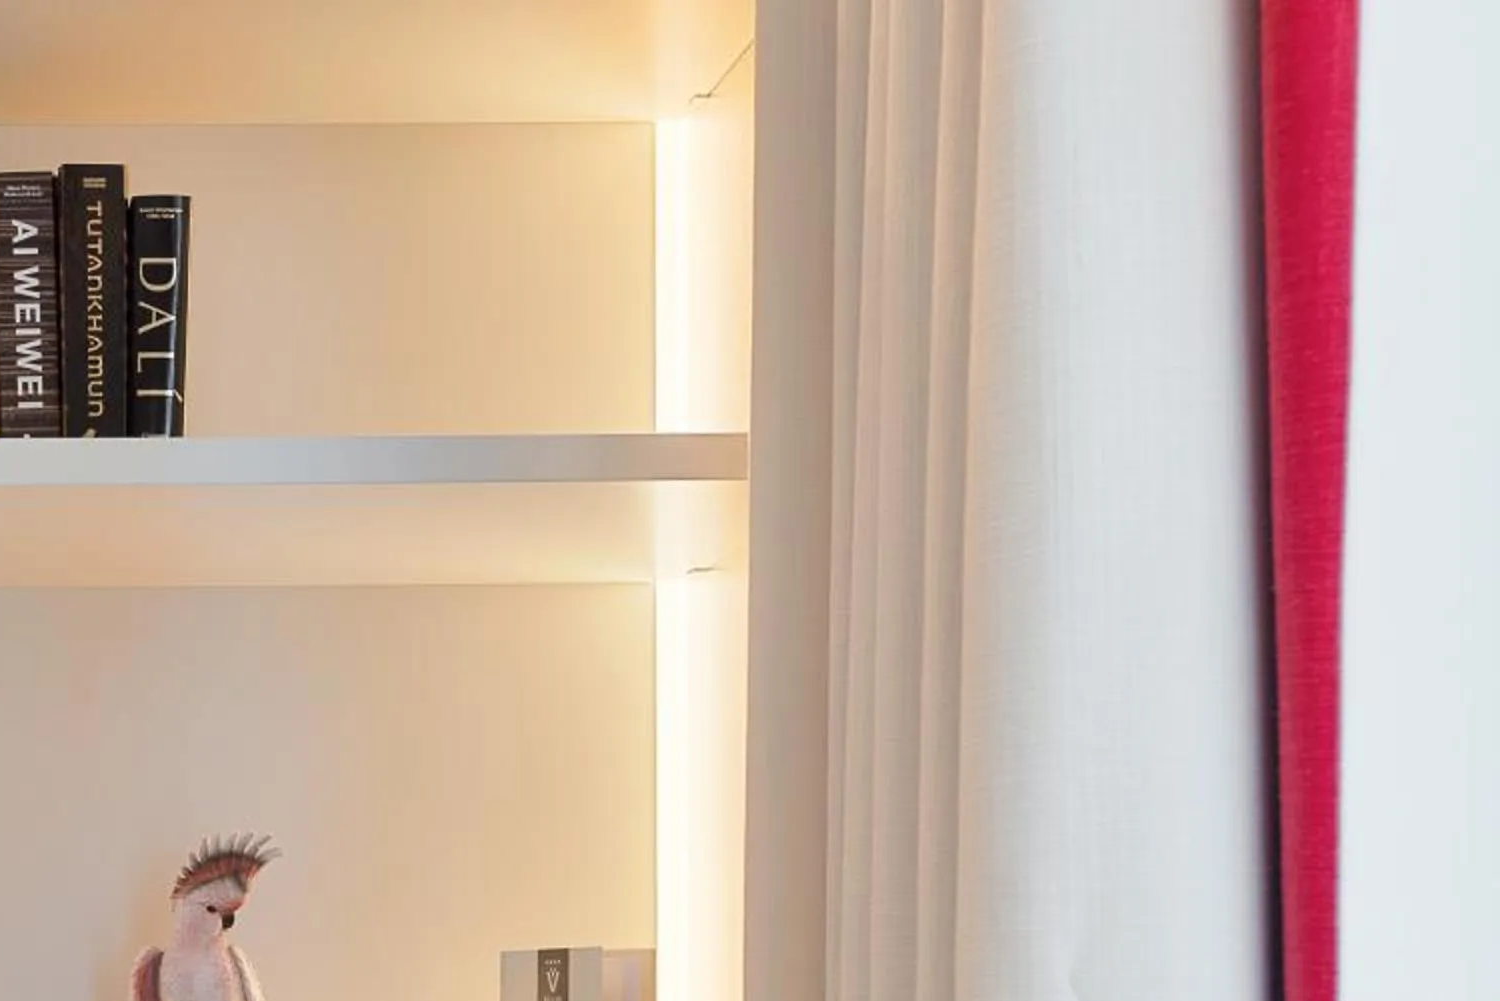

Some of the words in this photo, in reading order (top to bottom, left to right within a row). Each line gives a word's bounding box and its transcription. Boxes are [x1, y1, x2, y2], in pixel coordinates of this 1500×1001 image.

[10, 218, 40, 255] AI
[12, 265, 44, 409] WEIWEI
[136, 256, 183, 402] DALÍ
